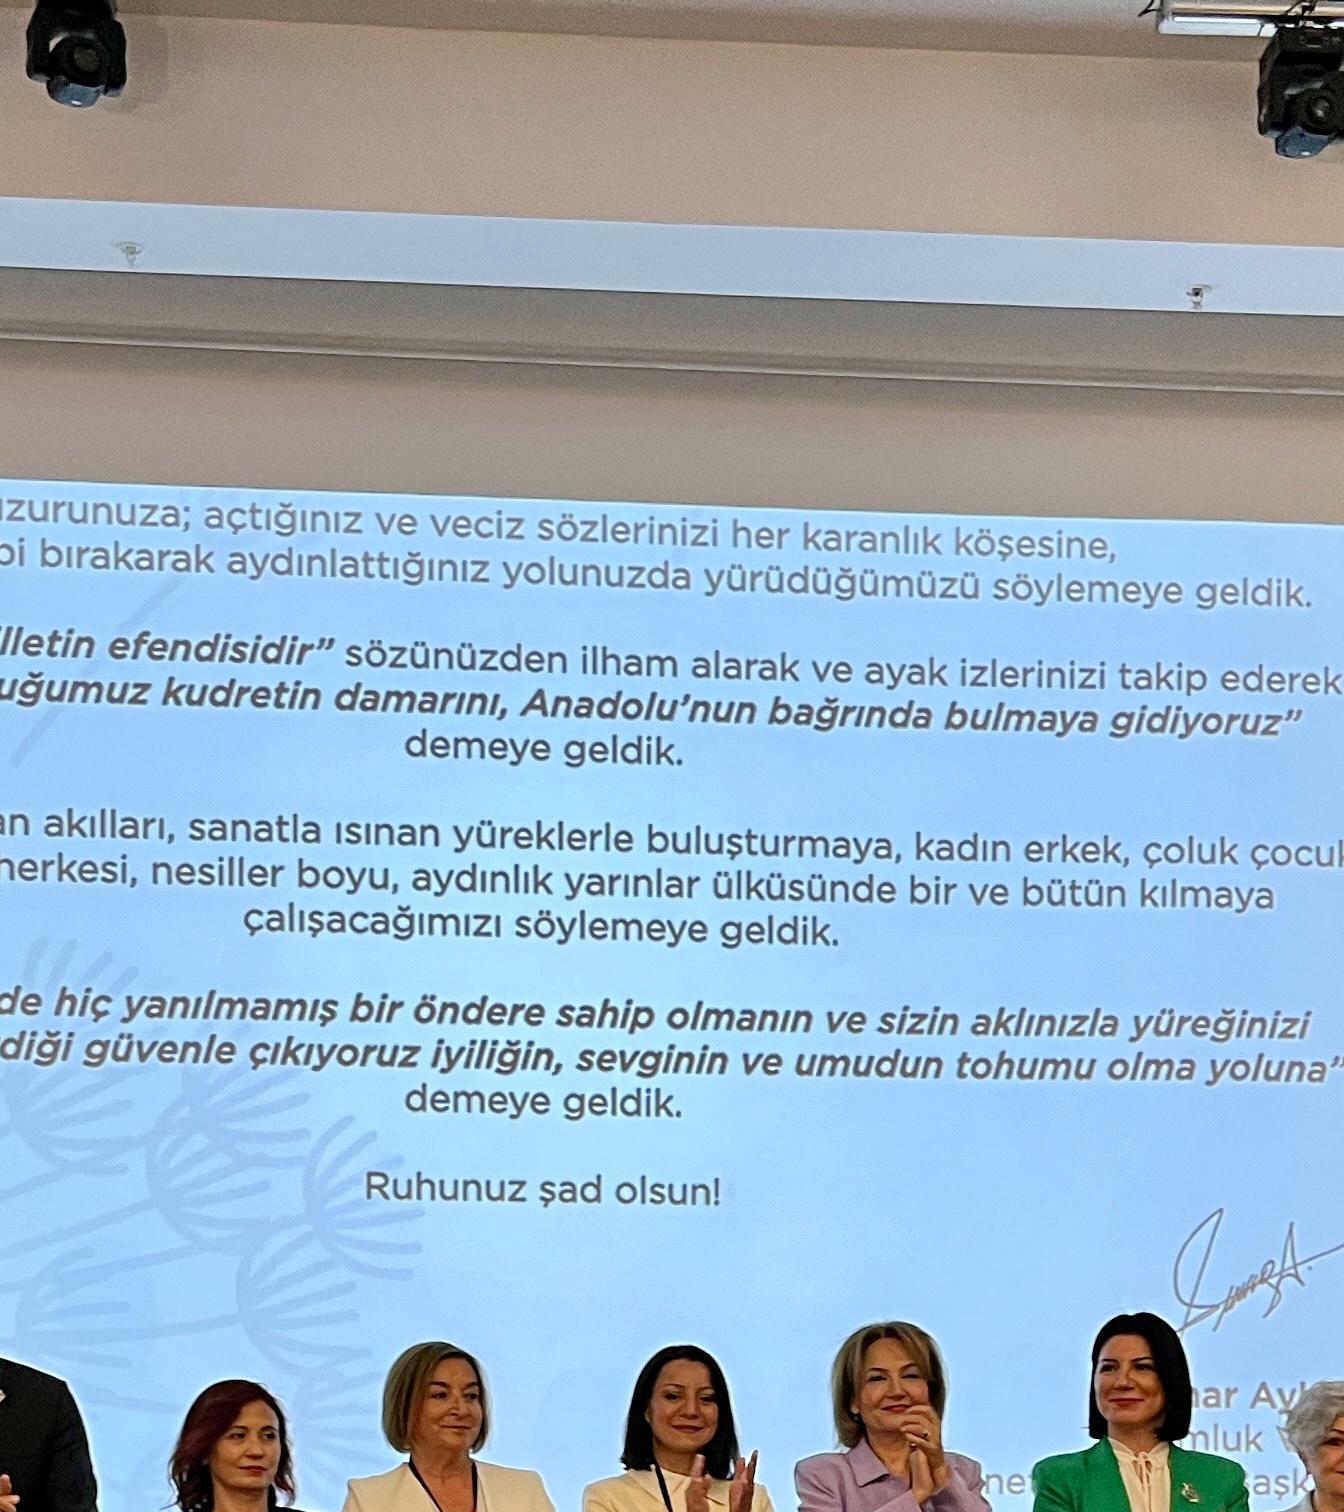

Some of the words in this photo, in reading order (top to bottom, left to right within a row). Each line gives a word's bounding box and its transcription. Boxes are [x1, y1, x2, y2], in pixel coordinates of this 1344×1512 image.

[203, 501, 364, 538] açtığınız
[374, 511, 419, 537] ve
[429, 509, 526, 541] veciz
[536, 512, 719, 548] sözlerinizi
[731, 517, 791, 550] her
[802, 521, 943, 556] karanlık
[954, 525, 1116, 564] köşesine,
[40, 536, 216, 574] bırakarak
[226, 545, 491, 587] aydınlattığınız
[501, 554, 692, 591] yolunuzda
[703, 563, 980, 602] yürüdüğümüzü
[991, 572, 1184, 610] söylemeye
[1194, 576, 1312, 611] geldik.
[344, 639, 568, 675] sözünüzden
[581, 644, 679, 679] ilham
[690, 649, 801, 683] alarak
[810, 659, 854, 684] ve
[863, 656, 949, 692] ayak
[959, 657, 1107, 690] izlerinizi
[1117, 661, 1208, 698] takip
[1219, 663, 1343, 696] ederek
[160, 675, 322, 711] kudretin
[333, 681, 509, 722] damarını,
[767, 695, 934, 733] bağrında
[943, 700, 1100, 739] bulmaya
[404, 727, 552, 768] demeye
[562, 733, 683, 769] geldik.
[43, 807, 176, 845] akılları,
[187, 812, 322, 845] sanatla
[335, 821, 441, 848] ısınan
[452, 819, 634, 855] yüreklerle
[647, 823, 903, 866] buluşturmaya,
[915, 830, 1012, 863] kadın
[1023, 833, 1130, 869] erkek,
[1142, 834, 1240, 870] çoluk
[151, 855, 286, 888] nesiller
[297, 857, 400, 896] boyu,
[411, 861, 554, 898] aydınlık
[562, 866, 702, 902] yarınlar
[712, 868, 898, 904] ülküsünde
[909, 873, 959, 906] bir
[967, 882, 1010, 907] ve
[1022, 875, 1127, 908] bütün
[1139, 877, 1274, 914] kılmaya
[243, 900, 502, 942] çalışacağımızı
[514, 908, 709, 949] söylemeye
[719, 913, 839, 950] geldik.
[52, 985, 114, 1024] hiç
[119, 988, 340, 1028] yanılmamış
[348, 991, 406, 1025] bir
[412, 993, 546, 1028] öndere
[554, 997, 656, 1036] sahip
[665, 999, 814, 1034] olmanın
[825, 1010, 868, 1035] ve
[875, 1004, 960, 1037] sizin
[969, 1005, 1120, 1039] aklınızla
[1127, 1007, 1313, 1044] yüreğinizi
[81, 1031, 238, 1069] güvenle
[248, 1034, 423, 1073] çıkıyoruz
[429, 1037, 564, 1077] iyiliğin,
[574, 1042, 730, 1080] sevginin
[741, 1051, 784, 1077] ve
[793, 1047, 944, 1080] umudun
[955, 1048, 1098, 1082] tohumu
[1105, 1050, 1197, 1082] olma
[404, 1081, 552, 1121] demeye
[562, 1085, 682, 1122] geldik.
[365, 1170, 528, 1203] Ruhunuz
[538, 1173, 603, 1209] şad
[614, 1174, 721, 1207] olsun!
